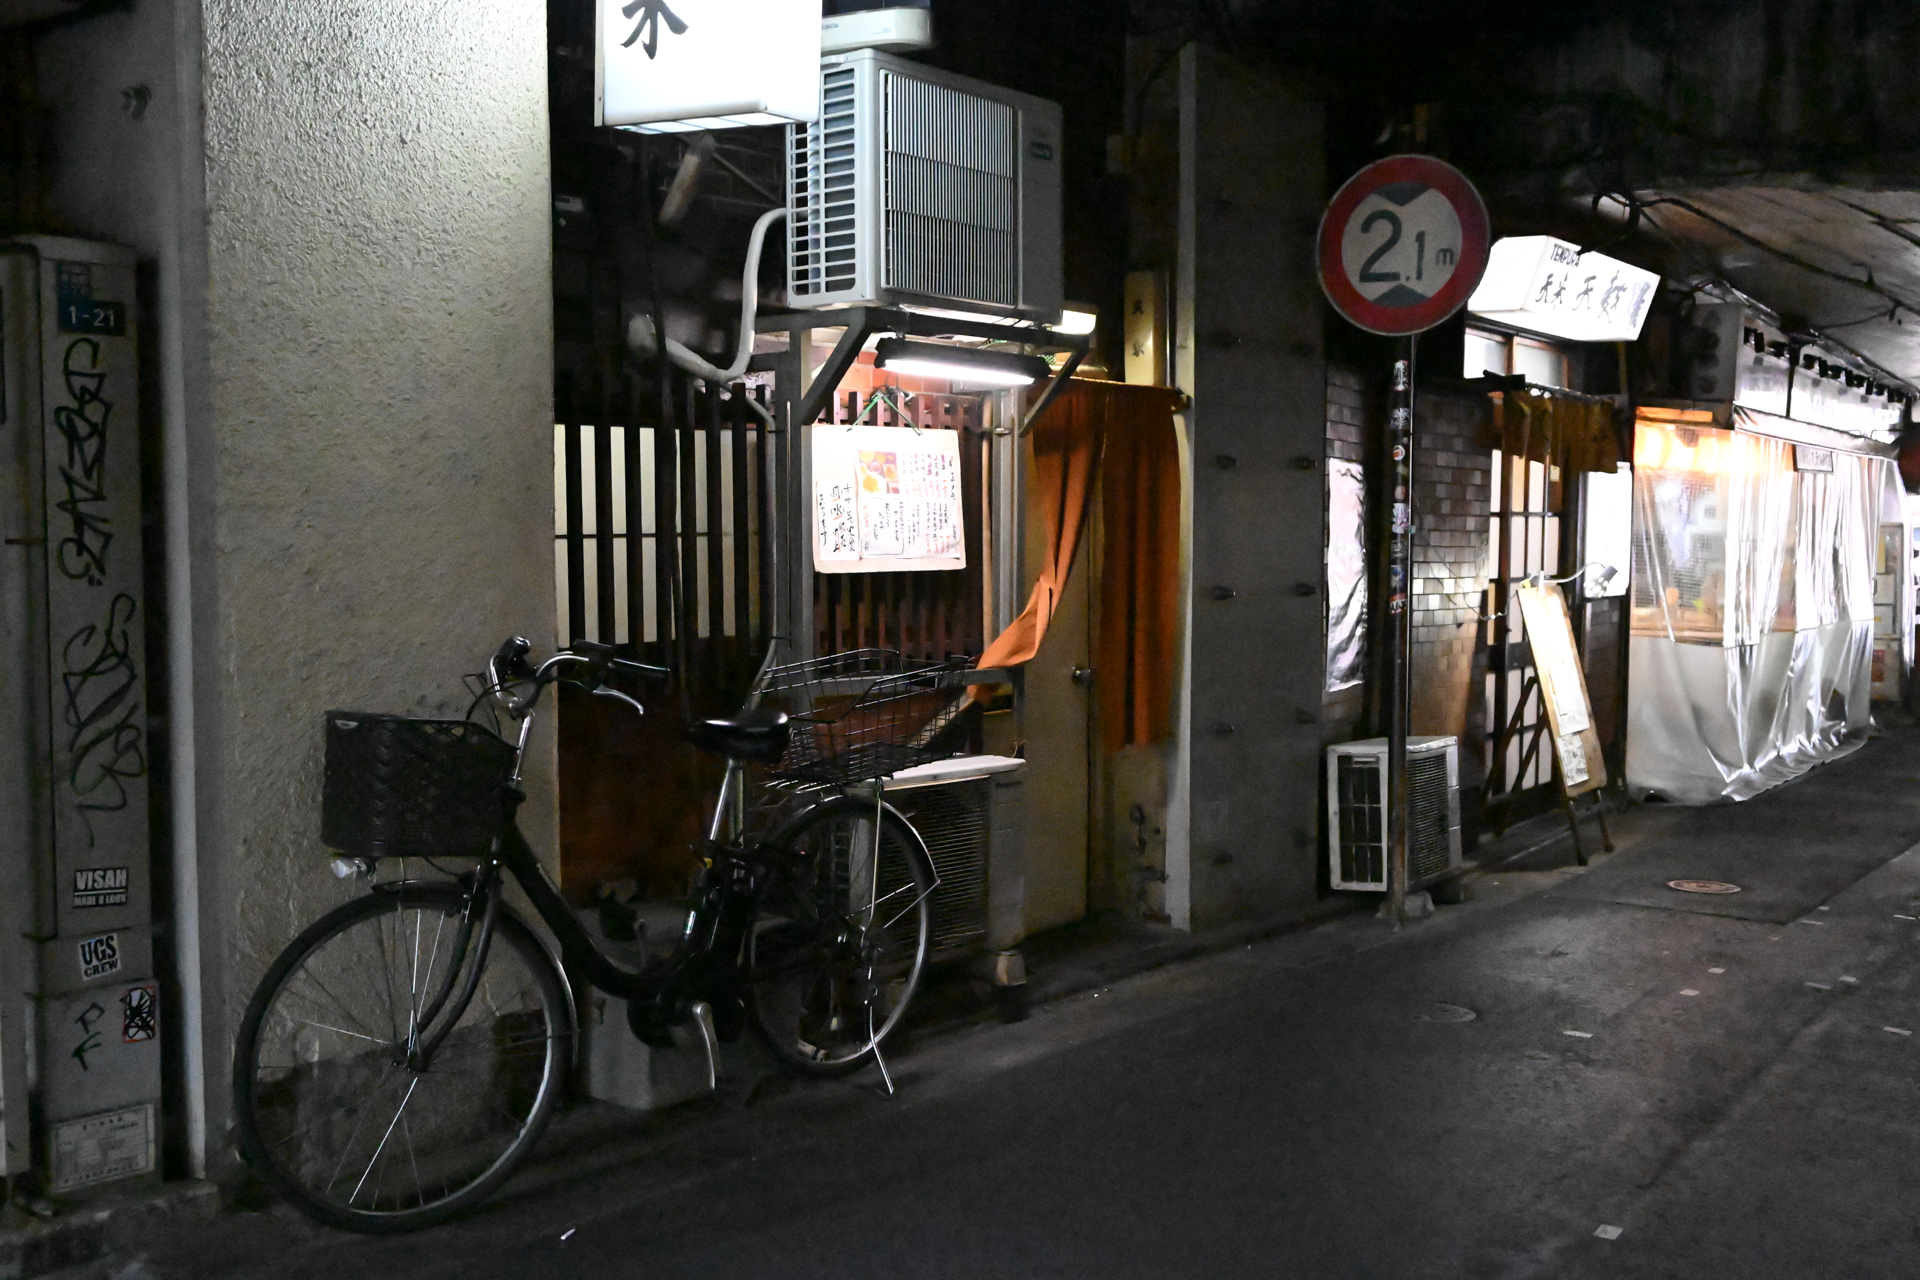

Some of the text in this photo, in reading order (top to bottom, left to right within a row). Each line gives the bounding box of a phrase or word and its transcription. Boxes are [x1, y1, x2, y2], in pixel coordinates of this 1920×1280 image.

[68, 305, 115, 327] 1-21
[80, 935, 117, 966] UGS
[83, 959, 119, 978] CREW
